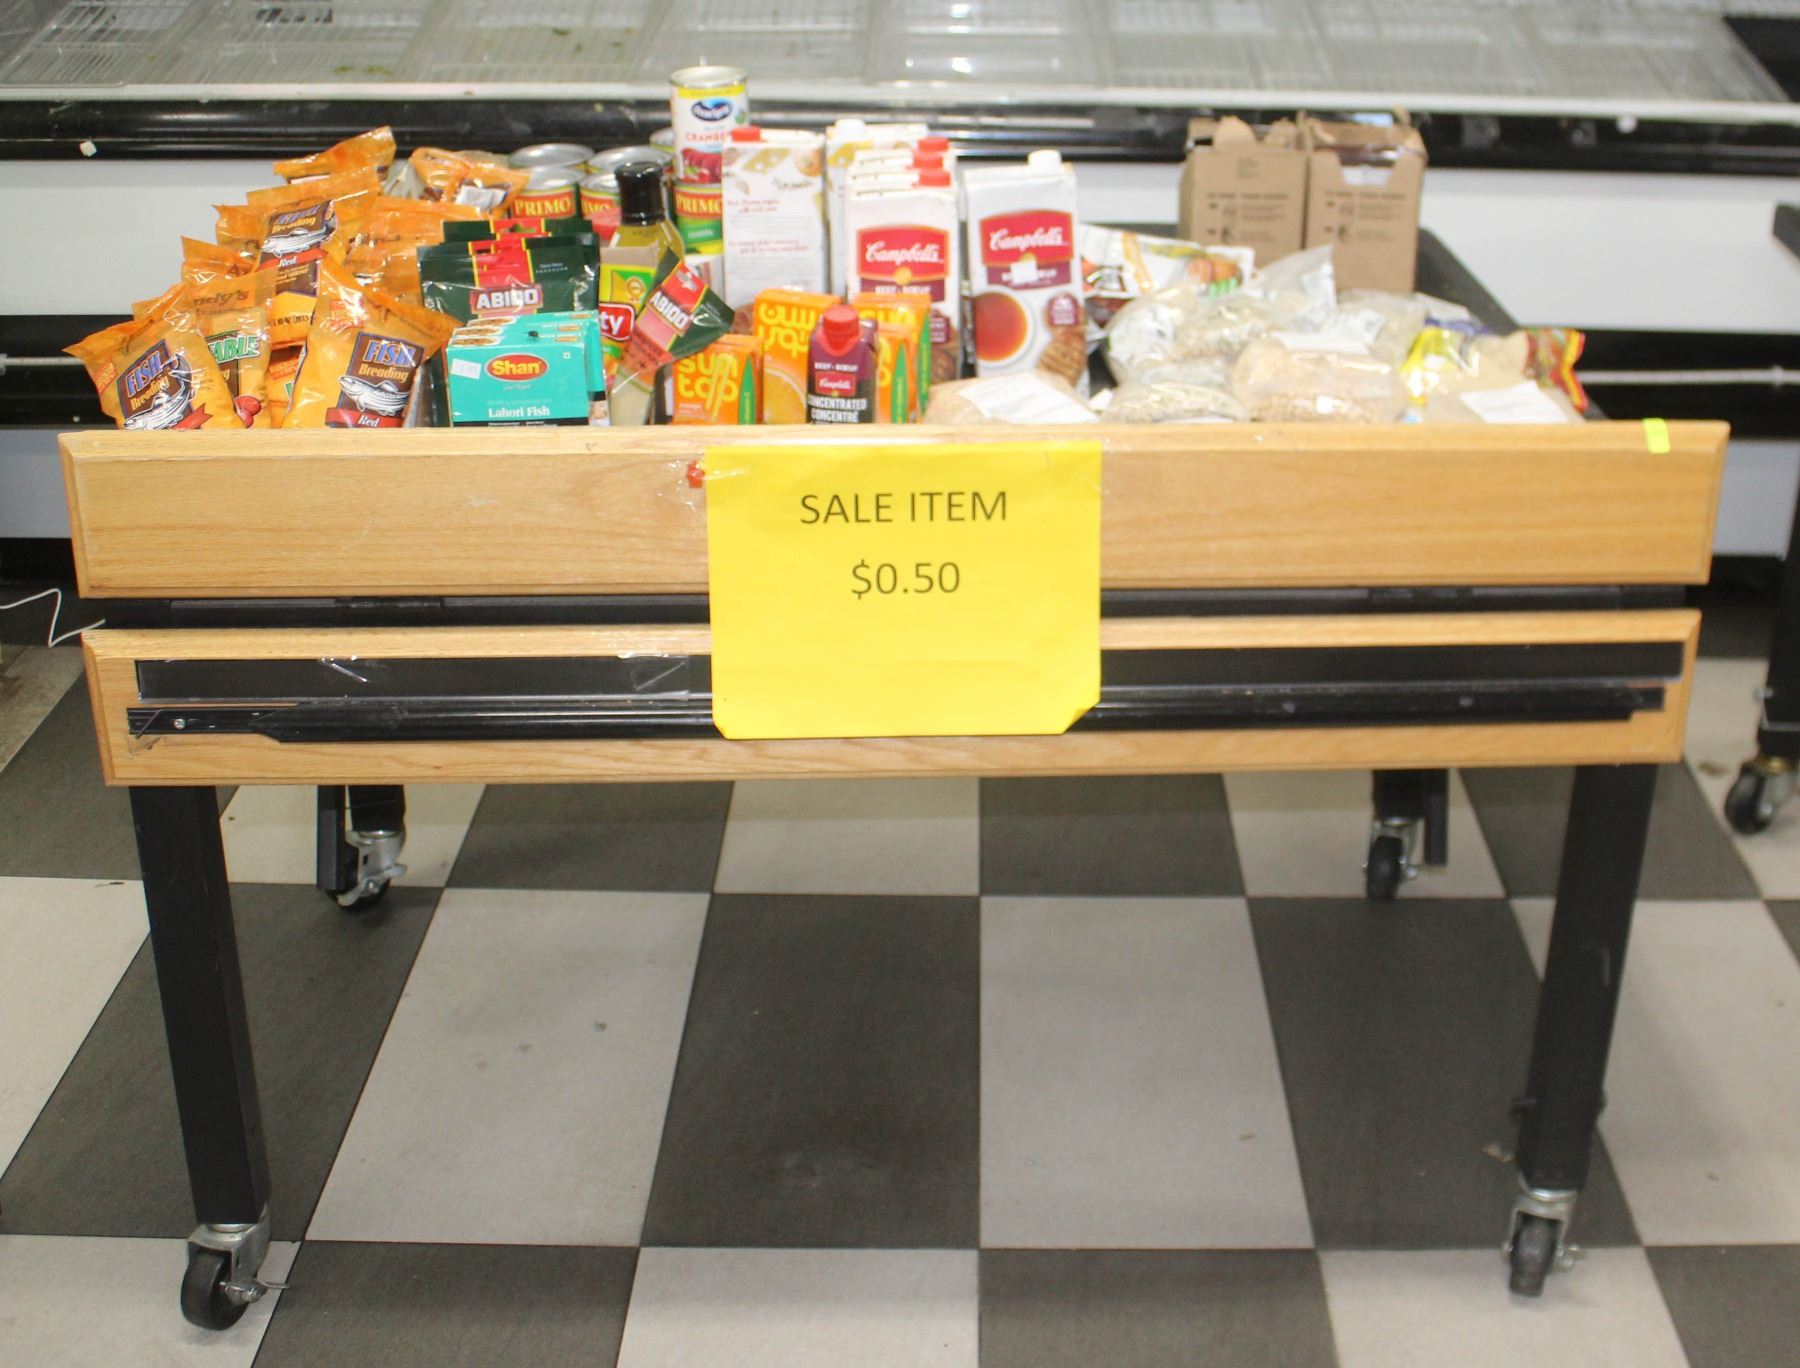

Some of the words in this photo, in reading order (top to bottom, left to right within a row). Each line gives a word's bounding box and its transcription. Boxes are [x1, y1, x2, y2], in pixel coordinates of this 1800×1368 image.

[515, 197, 571, 216] PRIMO
[650, 291, 690, 331] ABIDO
[363, 340, 417, 368] FISH
[491, 360, 541, 376] Shan
[125, 350, 164, 398] FISH
[358, 364, 410, 384] Breading
[130, 373, 171, 411] Breading
[358, 415, 381, 428] Red
[488, 406, 524, 418] Lahori
[527, 405, 551, 417] Fish
[800, 492, 893, 524] SALE
[910, 490, 1007, 523] ITEM
[851, 559, 961, 600] $0.50
